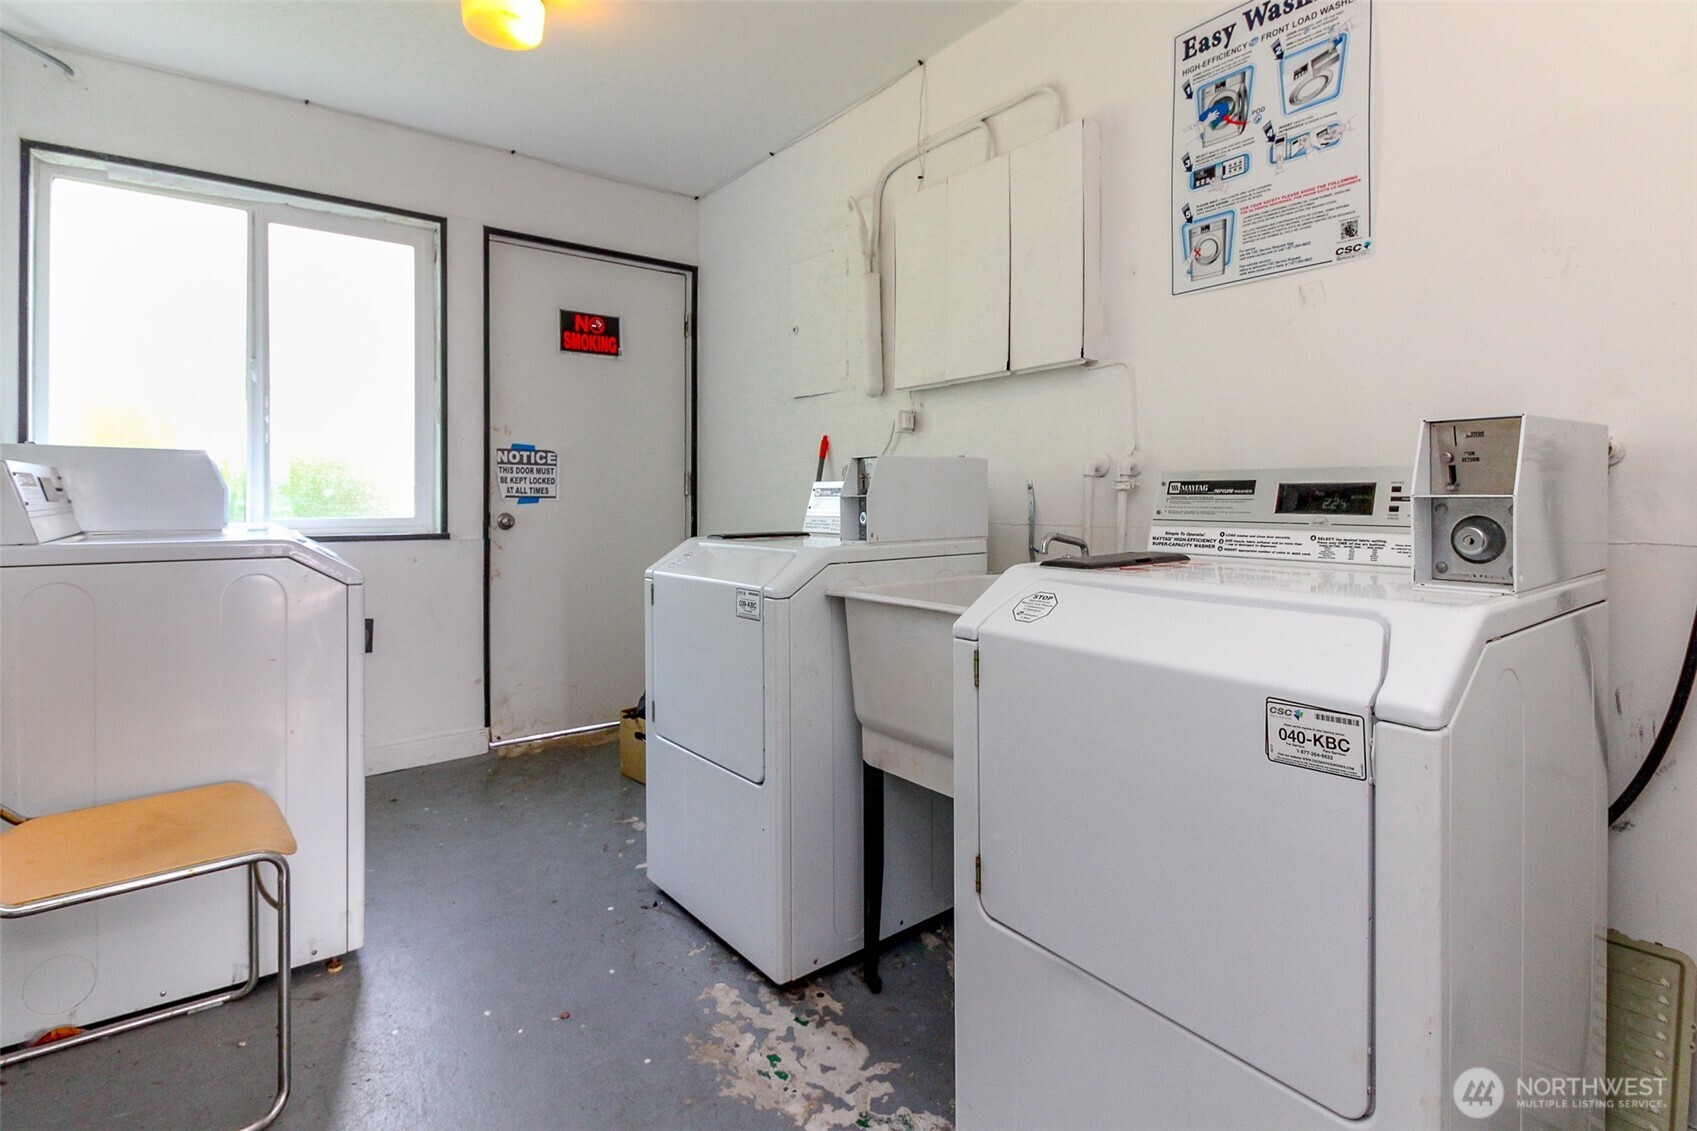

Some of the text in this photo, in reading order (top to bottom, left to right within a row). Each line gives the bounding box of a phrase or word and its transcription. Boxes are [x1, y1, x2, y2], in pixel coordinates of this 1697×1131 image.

[1182, 22, 1237, 62] Easy
[1182, 42, 1248, 76] HIGH-EFFICIENCY
[1261, 24, 1290, 42] FRONT
[1292, 12, 1318, 28] LOAD
[1252, 106, 1266, 116] POD
[1336, 244, 1362, 255] CSC
[575, 314, 605, 334] NO
[563, 331, 617, 354] SMOKING
[497, 451, 556, 464] NOTICE
[498, 466, 554, 475] THIS DOOR MUST
[500, 476, 555, 485] BE KEPT LOCKED
[529, 487, 549, 495] TIMES
[1270, 706, 1292, 716] CSC
[1278, 727, 1350, 752] 040-KBC
[1296, 749, 1333, 760] 1-877-264-6622
